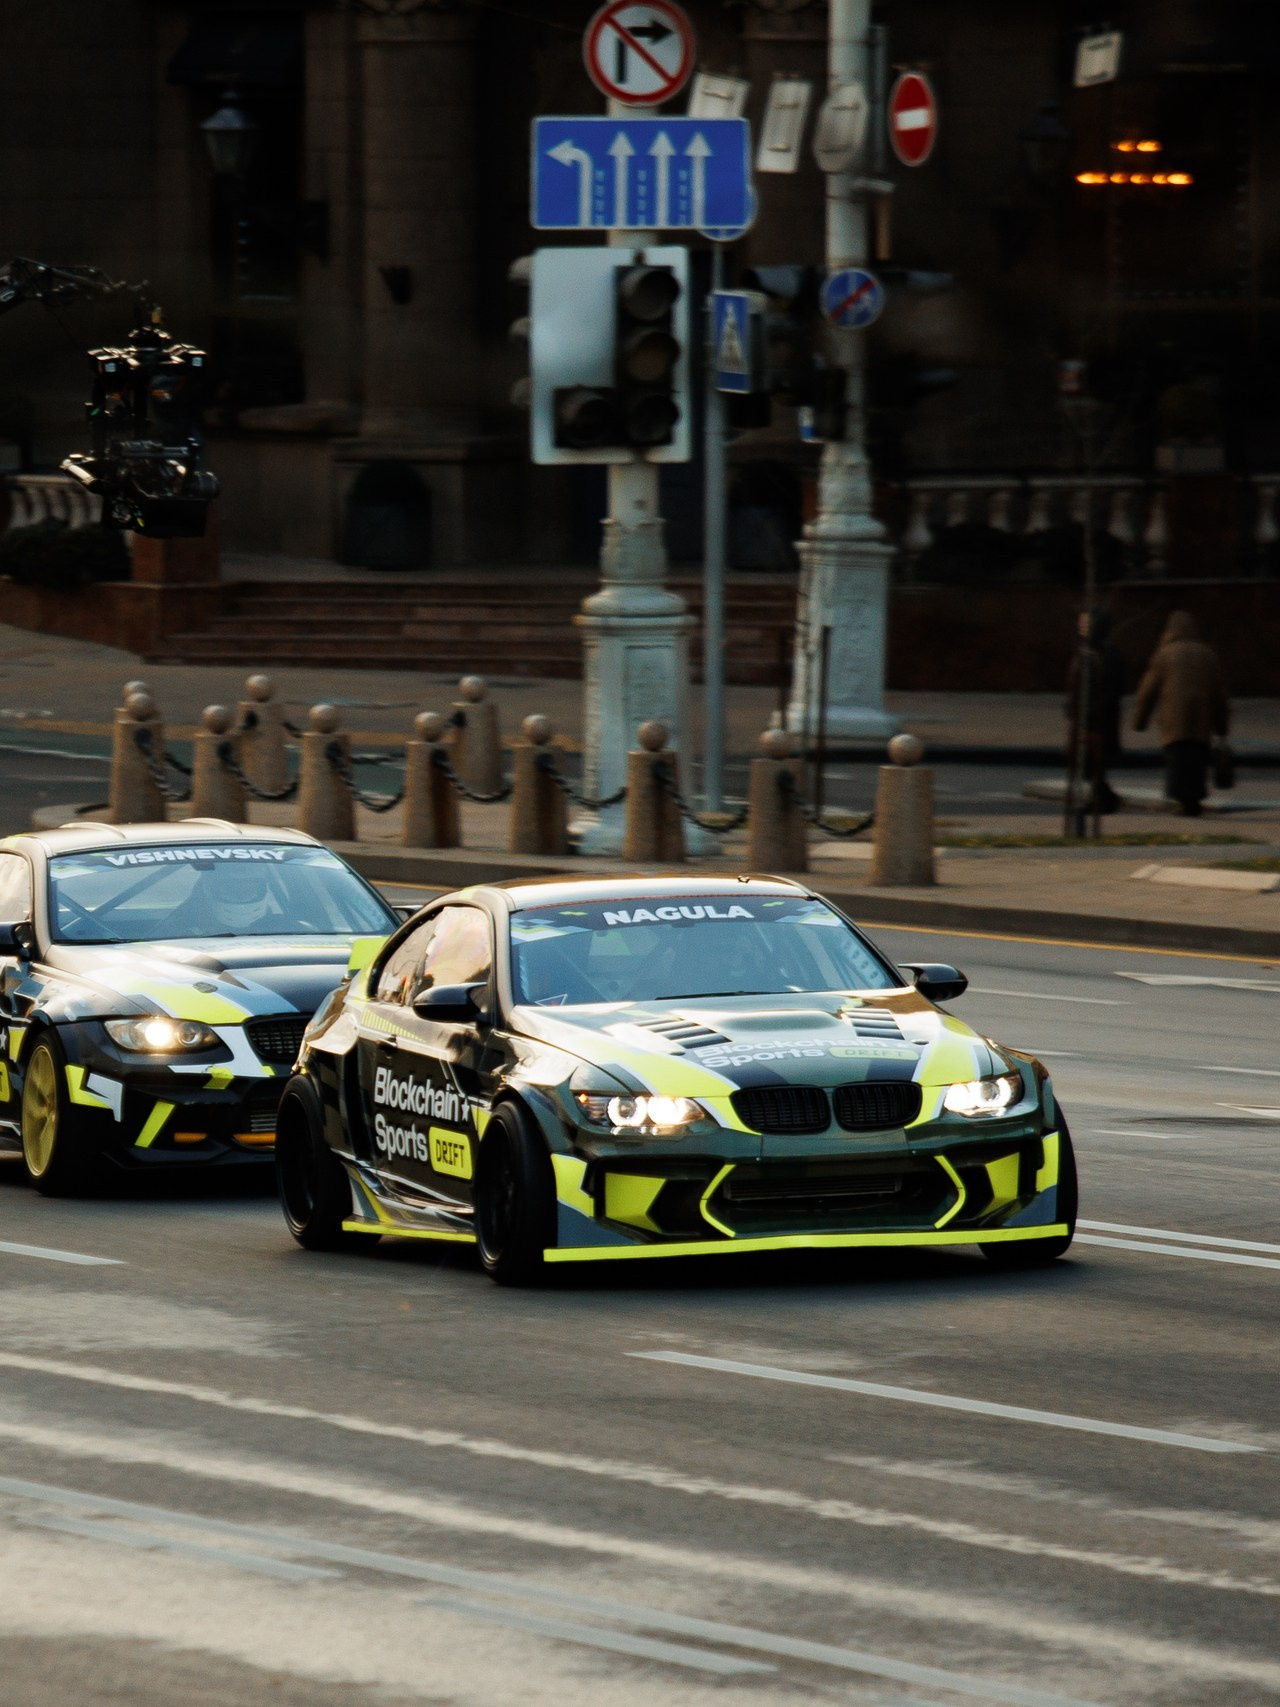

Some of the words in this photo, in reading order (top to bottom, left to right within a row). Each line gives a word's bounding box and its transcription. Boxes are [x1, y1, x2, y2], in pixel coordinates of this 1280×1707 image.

[105, 848, 285, 866] VISHNEVSKY
[602, 905, 755, 925] NAGULA
[693, 1037, 883, 1059] Blockchain
[701, 1046, 825, 1068] Sports
[844, 1048, 905, 1058] DRIFT
[374, 1066, 459, 1122] Blockchain
[375, 1113, 428, 1162] Sports
[435, 1139, 465, 1169] DRIFT
